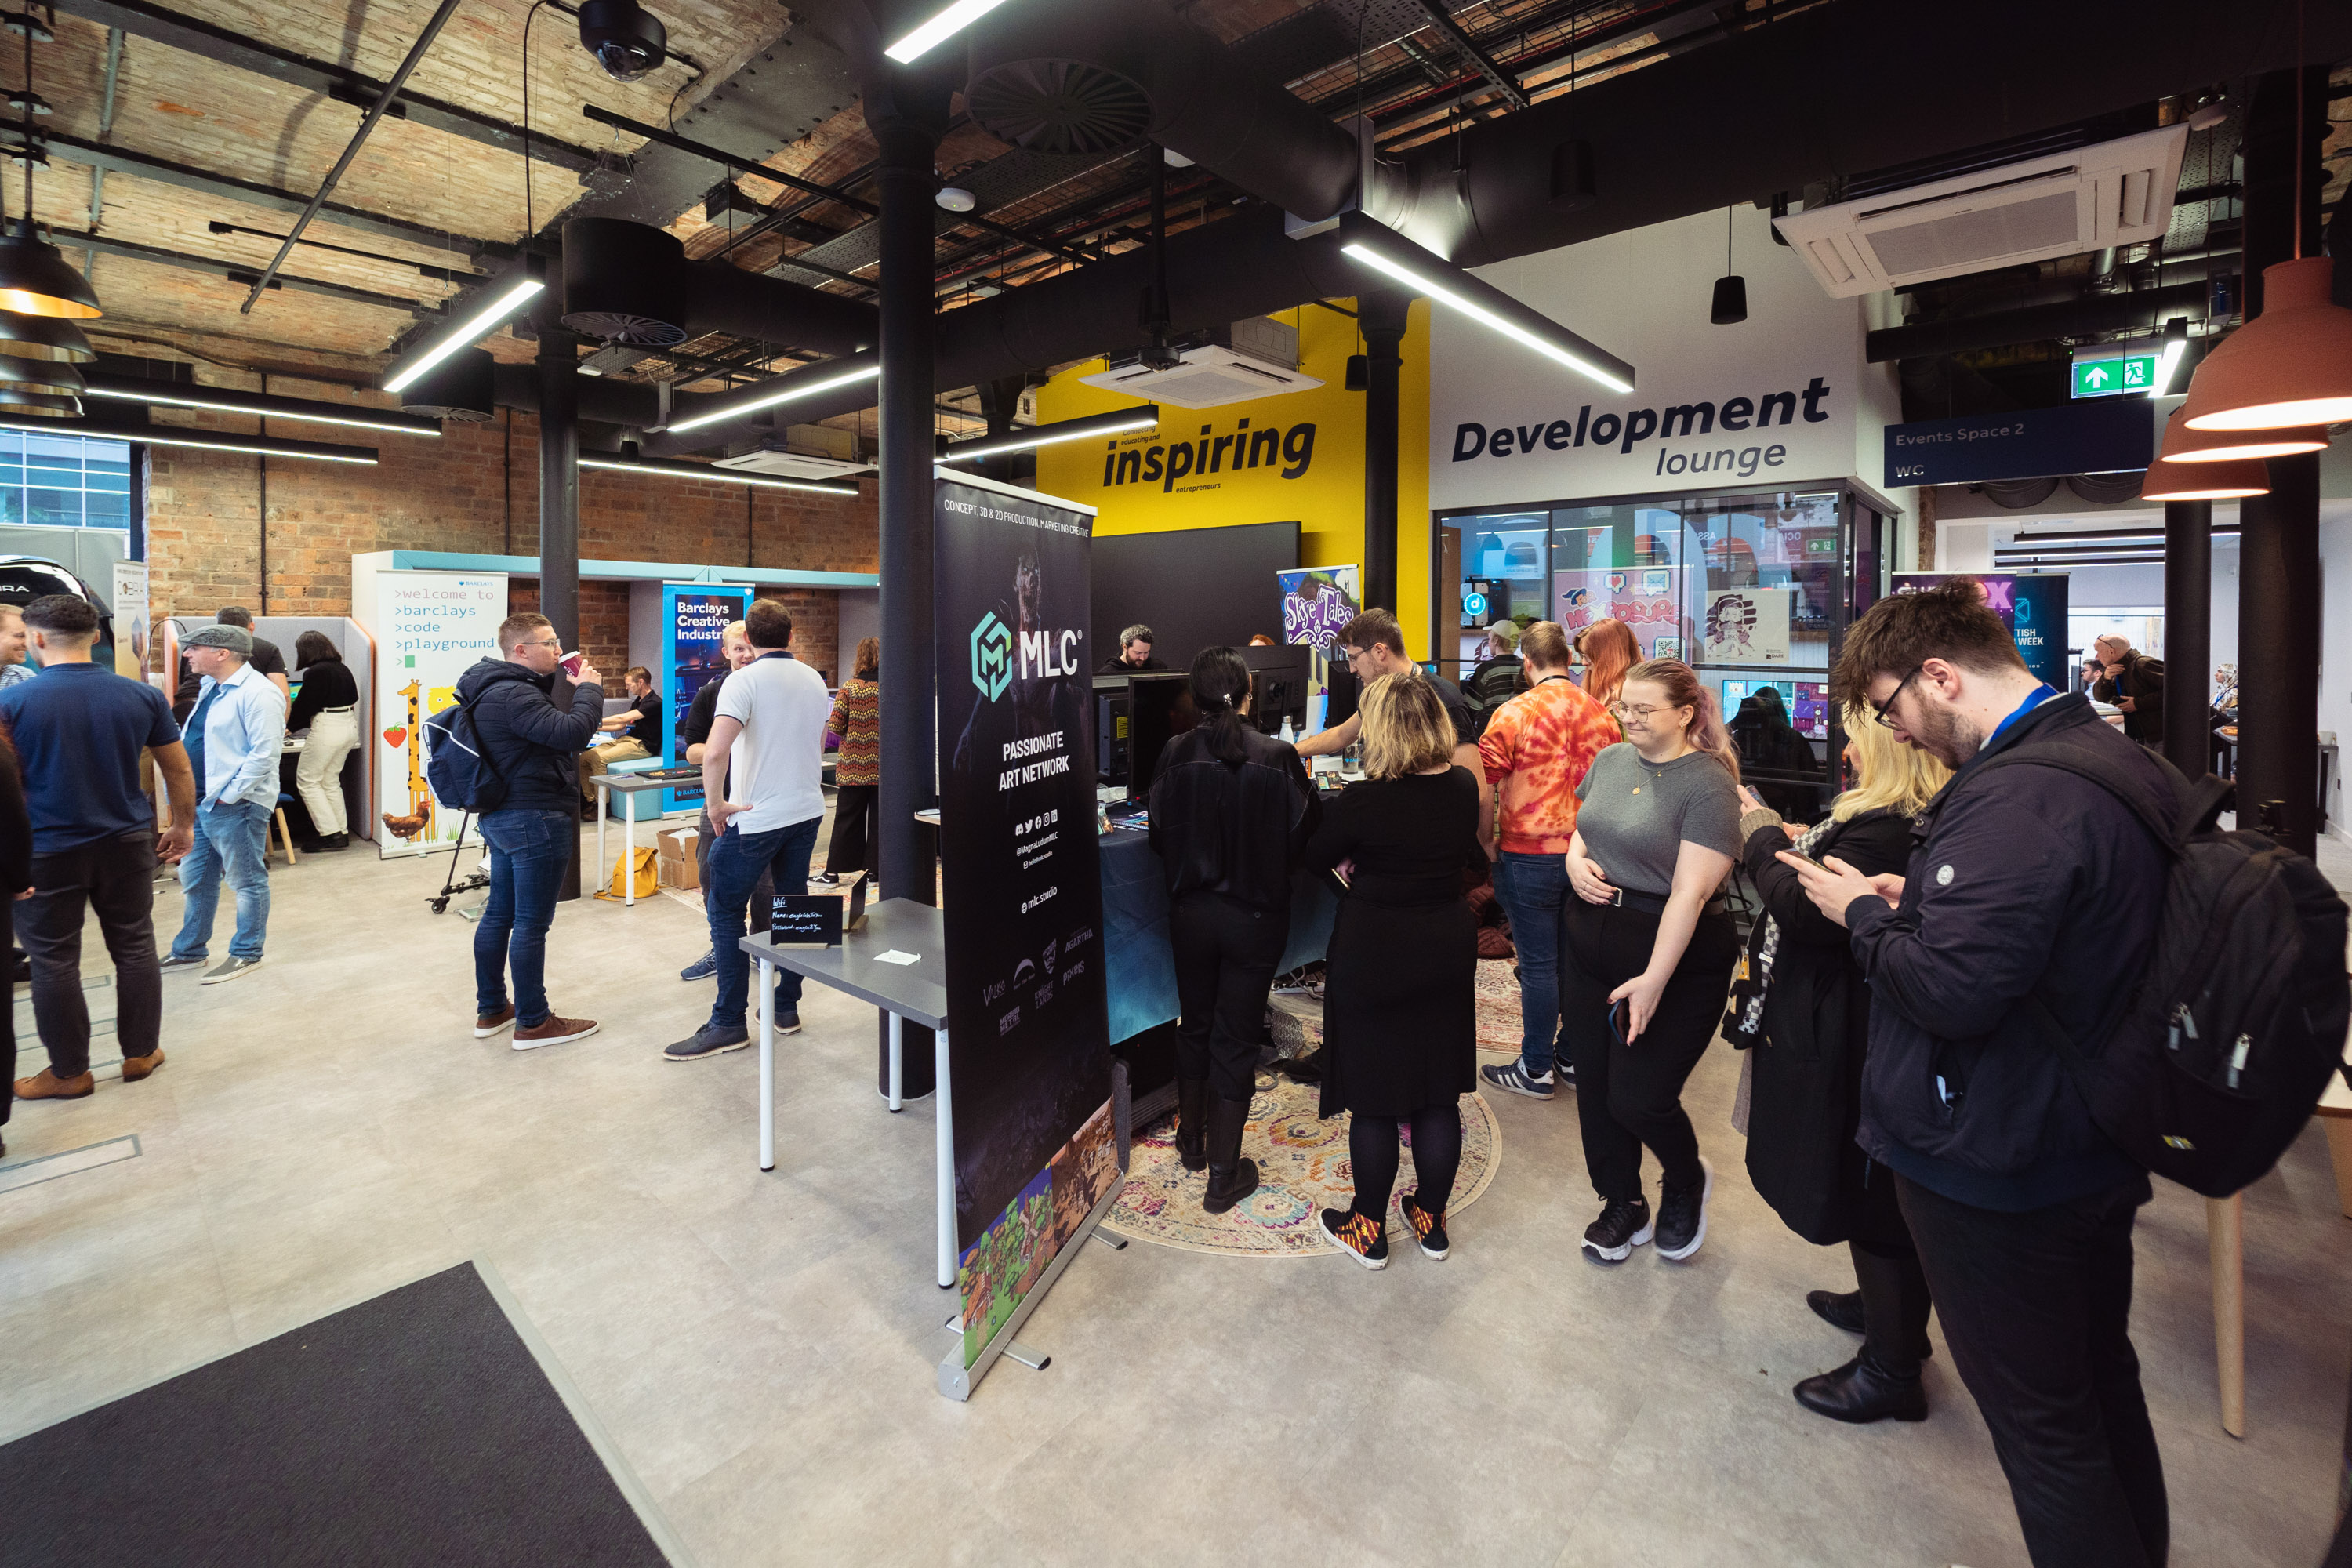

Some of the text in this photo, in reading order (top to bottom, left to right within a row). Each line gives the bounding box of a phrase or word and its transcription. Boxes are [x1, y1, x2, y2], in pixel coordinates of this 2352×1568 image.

[1452, 377, 1830, 462] Development
[1121, 436, 1149, 445] educating
[1896, 423, 2024, 446] Events Space 2
[1103, 418, 1317, 493] inspiring
[1655, 444, 1787, 477] lounge
[1896, 464, 1925, 477] WC
[1176, 481, 1221, 493] entrepreneurs
[944, 499, 979, 517] CONCEPT,
[979, 506, 988, 518] 3D
[989, 509, 994, 519] &
[995, 510, 1004, 521] 2D
[1040, 519, 1069, 534] MARKETING
[1069, 524, 1089, 538] CREATIVE
[477, 590, 494, 600] to
[677, 601, 729, 616] Barclays
[677, 615, 730, 626] Creative
[1286, 586, 1352, 631] Skye Tales
[2018, 637, 2044, 646] WEEK
[1003, 731, 1064, 762] PASSIONATE
[999, 755, 1070, 792] ART NETWORK
[1016, 831, 1058, 856] @MagnaLudumMLC
[1028, 886, 1058, 909] mlc.studio
[1065, 928, 1094, 953] AGARTHA
